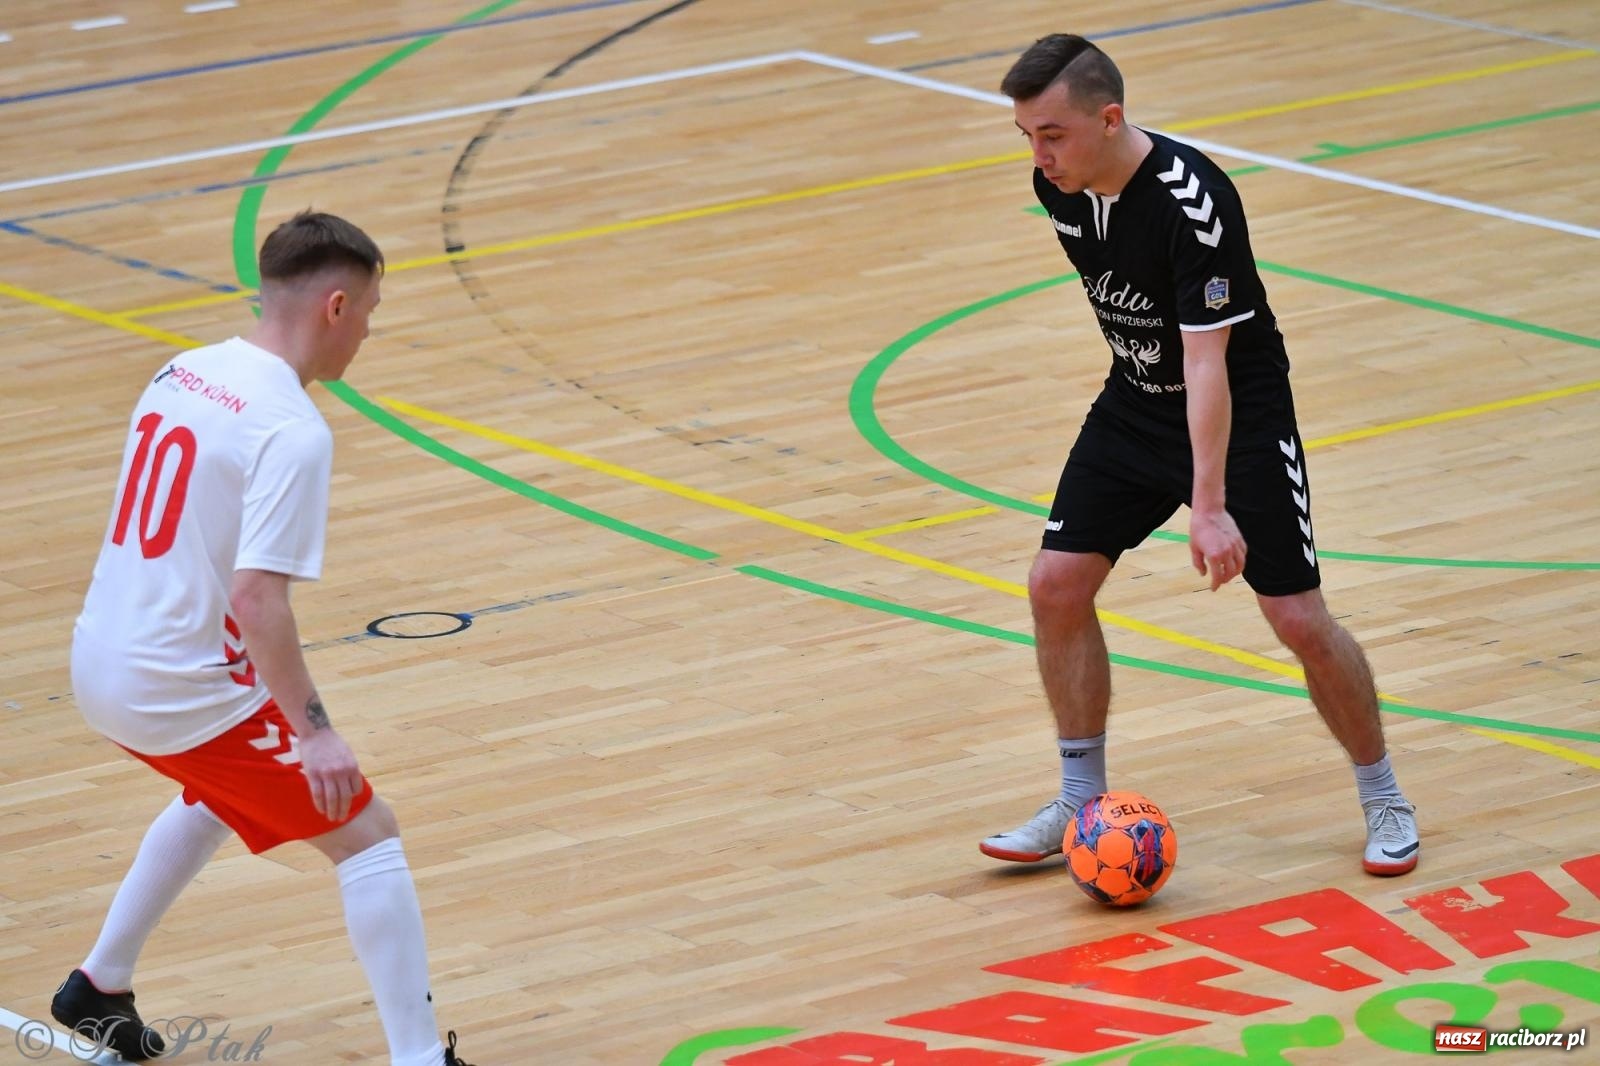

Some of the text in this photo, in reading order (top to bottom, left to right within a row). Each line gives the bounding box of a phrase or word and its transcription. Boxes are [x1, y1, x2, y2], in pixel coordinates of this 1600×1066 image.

[1112, 313, 1164, 328] FRYZJERSKI
[170, 367, 204, 392] PRD
[112, 412, 197, 559] 10
